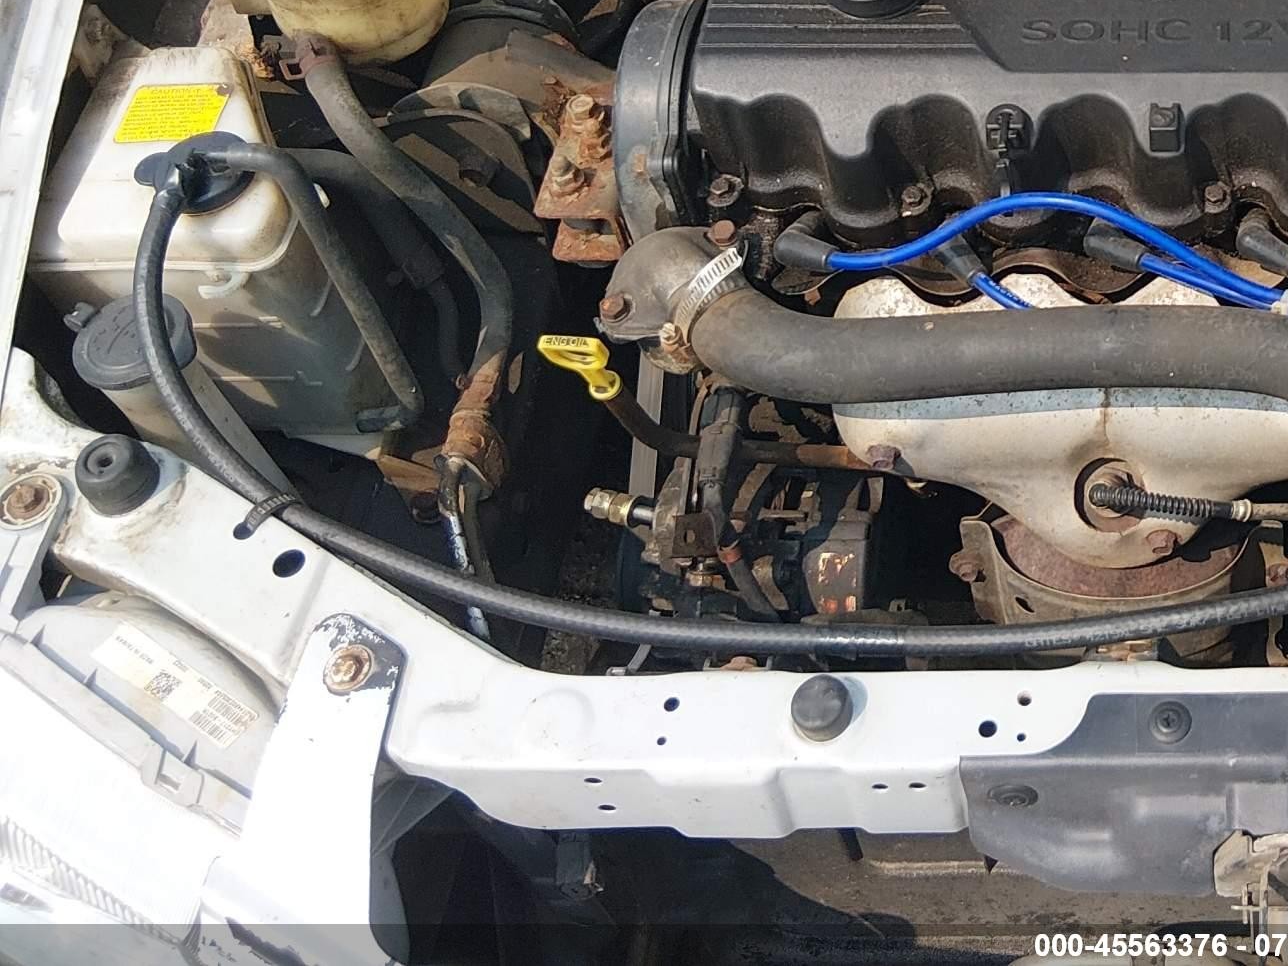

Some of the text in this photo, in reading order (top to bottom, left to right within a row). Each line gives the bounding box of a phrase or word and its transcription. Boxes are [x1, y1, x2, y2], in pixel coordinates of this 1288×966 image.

[1022, 19, 1193, 42] SOHC
[544, 337, 589, 347] ENG OIL
